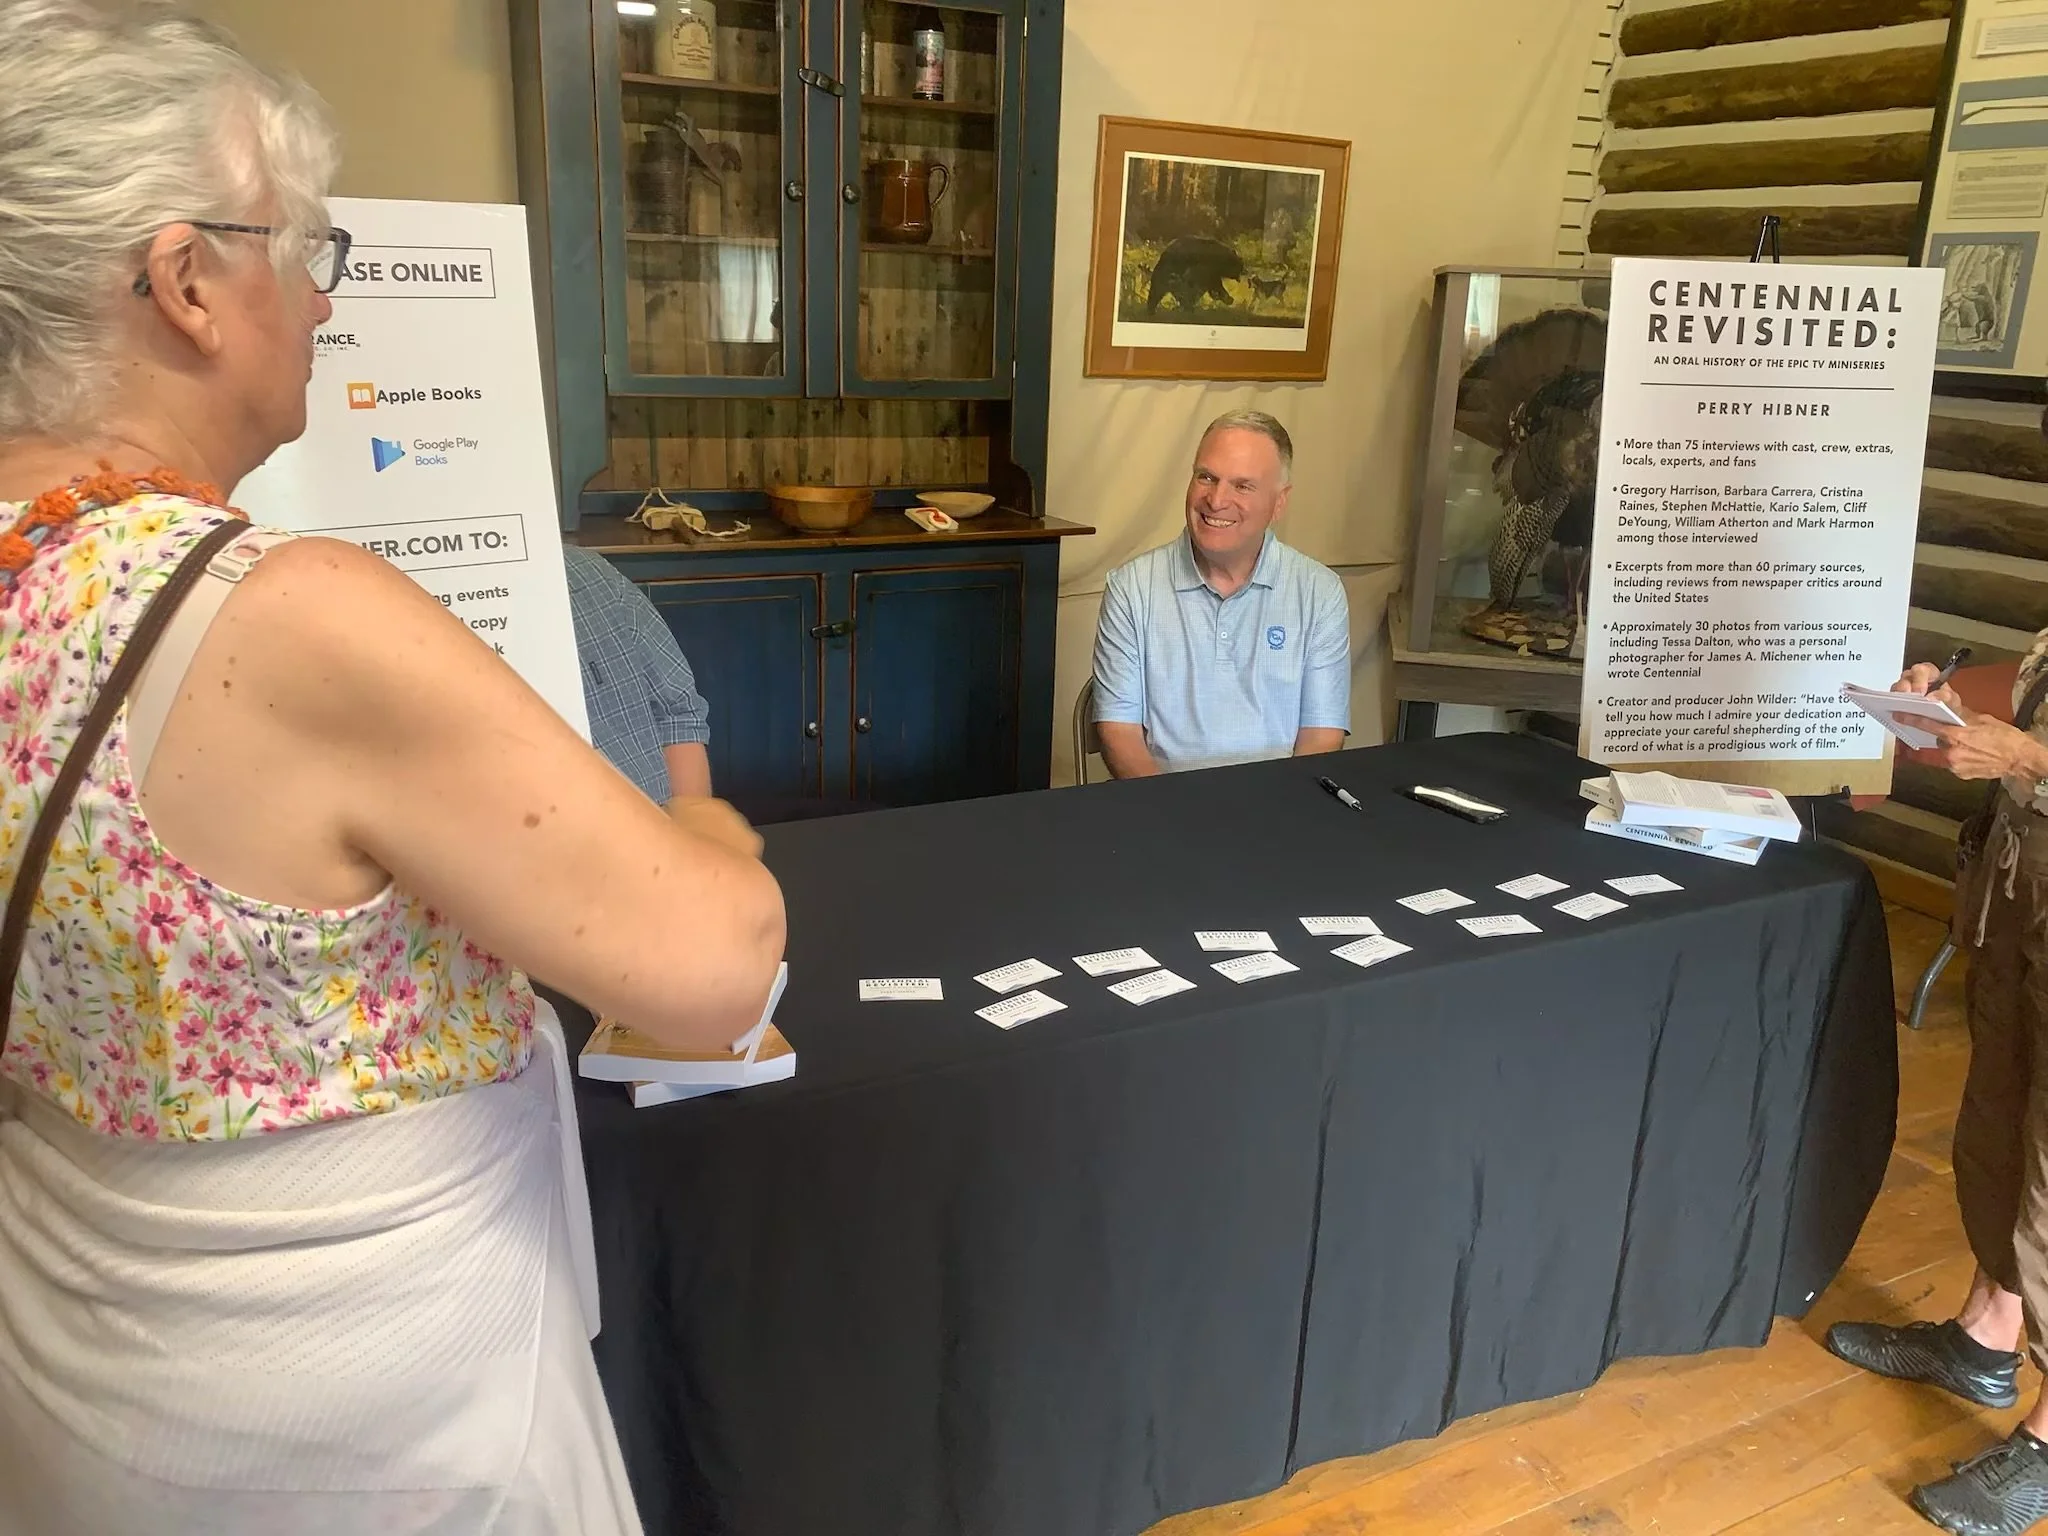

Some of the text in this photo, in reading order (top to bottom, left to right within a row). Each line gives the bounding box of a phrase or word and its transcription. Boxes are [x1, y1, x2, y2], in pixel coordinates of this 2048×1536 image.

[391, 263, 483, 282] ONLINE
[1649, 279, 1901, 312] CENTENNIAL
[1648, 313, 1896, 349] REVISITED:
[312, 334, 356, 345] ANCE
[1653, 355, 1885, 370] AN ORAL HISTORY OF THE EPIC TV MINISERIES
[376, 387, 482, 405] Apple Books
[1697, 401, 1829, 416] PERRY HIBNER
[413, 437, 479, 452] Google Play
[1624, 438, 1893, 454] More than 75 interviews with cast, crew, extras,
[415, 455, 448, 466] Books
[1622, 454, 1756, 469] locals, experts, and fans
[1620, 484, 1863, 498] Gregory Harrison, Barbara Carrera, Cristina
[1619, 500, 1867, 514] Raines, Stephen McHattie, Kario Salem, Cliff
[1618, 515, 1874, 530] DeYoung, William Atherton and Mark Harmon
[468, 531, 508, 550] TO:
[1616, 531, 1758, 545] among those interviewed
[1615, 561, 1663, 574] Excerpts
[1666, 560, 1692, 571] from
[1727, 560, 1752, 571] than
[1755, 561, 1770, 571] 60
[1773, 561, 1816, 575] primary
[1819, 564, 1865, 573] sources,
[1613, 576, 1882, 590] including reviews from newspaper critics around
[457, 586, 509, 602] events
[1612, 592, 1709, 603] the United States
[470, 616, 508, 631] copy
[1610, 619, 1872, 635] Approximately 30 photos from various sources,
[1609, 635, 1847, 650] including Tessa Dalton, who was a personal
[1608, 650, 1862, 666] photographer for James A. Michener when he
[1607, 666, 1701, 678] wrote Centennial
[1606, 696, 1648, 707] Creator
[1651, 694, 1671, 706] and
[1674, 694, 1724, 708] producer
[1727, 693, 1753, 704] John
[1757, 693, 1796, 704] Wilder:
[1839, 694, 1850, 704] to
[1605, 711, 1623, 722] tell
[1625, 713, 1646, 724] you
[1649, 710, 1673, 721] how
[1675, 709, 1704, 720] much
[1708, 710, 1711, 720] I
[1714, 709, 1752, 720] admire
[1755, 711, 1781, 722] your
[1783, 708, 1842, 719] dedication
[1604, 722, 1865, 740] appreciate your careful shepherding of the only
[1603, 741, 1638, 753] record
[1641, 740, 1654, 751] of
[1656, 740, 1683, 751] what
[1686, 740, 1695, 750] is
[1698, 742, 1704, 750] a
[1707, 739, 1766, 752] prodigious
[1769, 738, 1797, 749] work
[1800, 738, 1813, 748] of
[1625, 826, 1672, 842] CENTENNIAL
